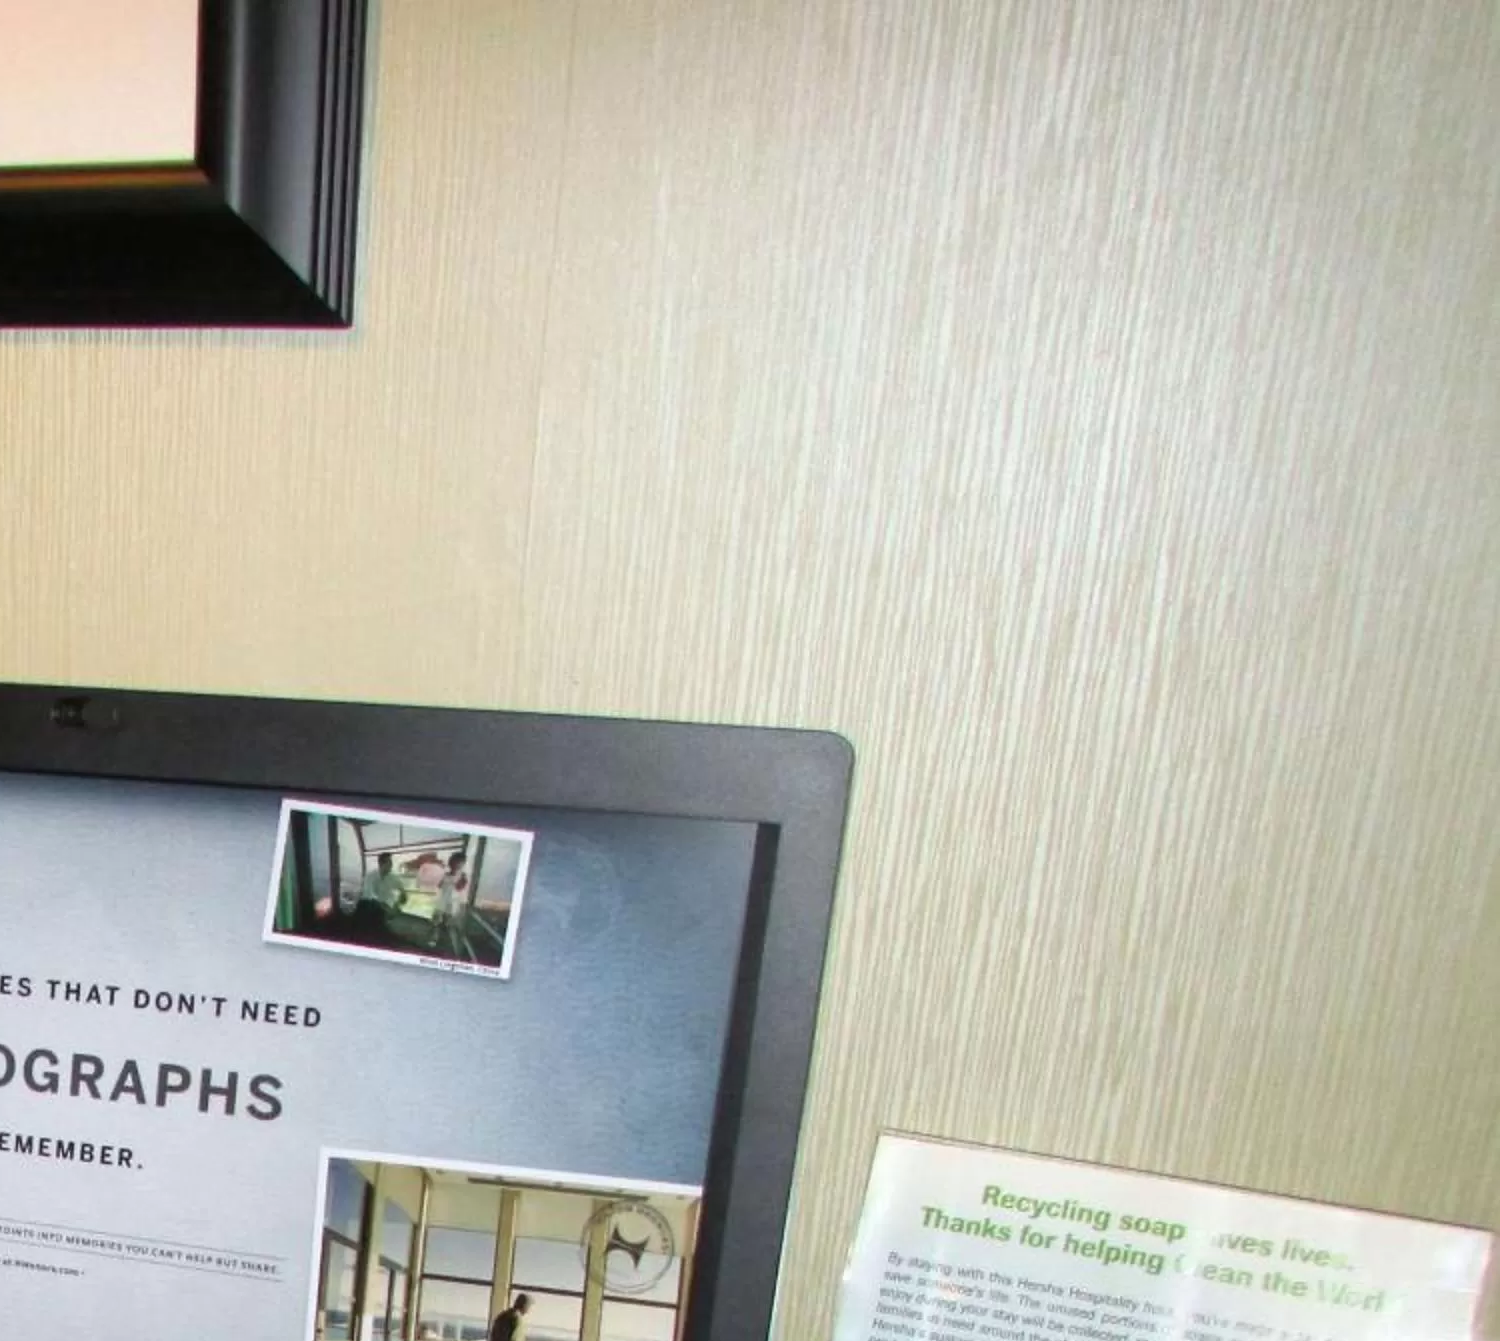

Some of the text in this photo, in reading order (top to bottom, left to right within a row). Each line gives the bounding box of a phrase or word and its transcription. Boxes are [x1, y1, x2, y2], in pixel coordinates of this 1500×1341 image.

[47, 980, 121, 1008] THAT
[134, 990, 228, 1018] DON'T
[241, 1000, 322, 1028] NEED
[979, 1184, 1112, 1231] Recycling
[1116, 1211, 1187, 1245] soap
[917, 1206, 1013, 1244] Thanks
[1017, 1224, 1058, 1252] for
[1060, 1233, 1166, 1275] helping
[1171, 1252, 1255, 1288] Cean
[1260, 1269, 1310, 1298] the
